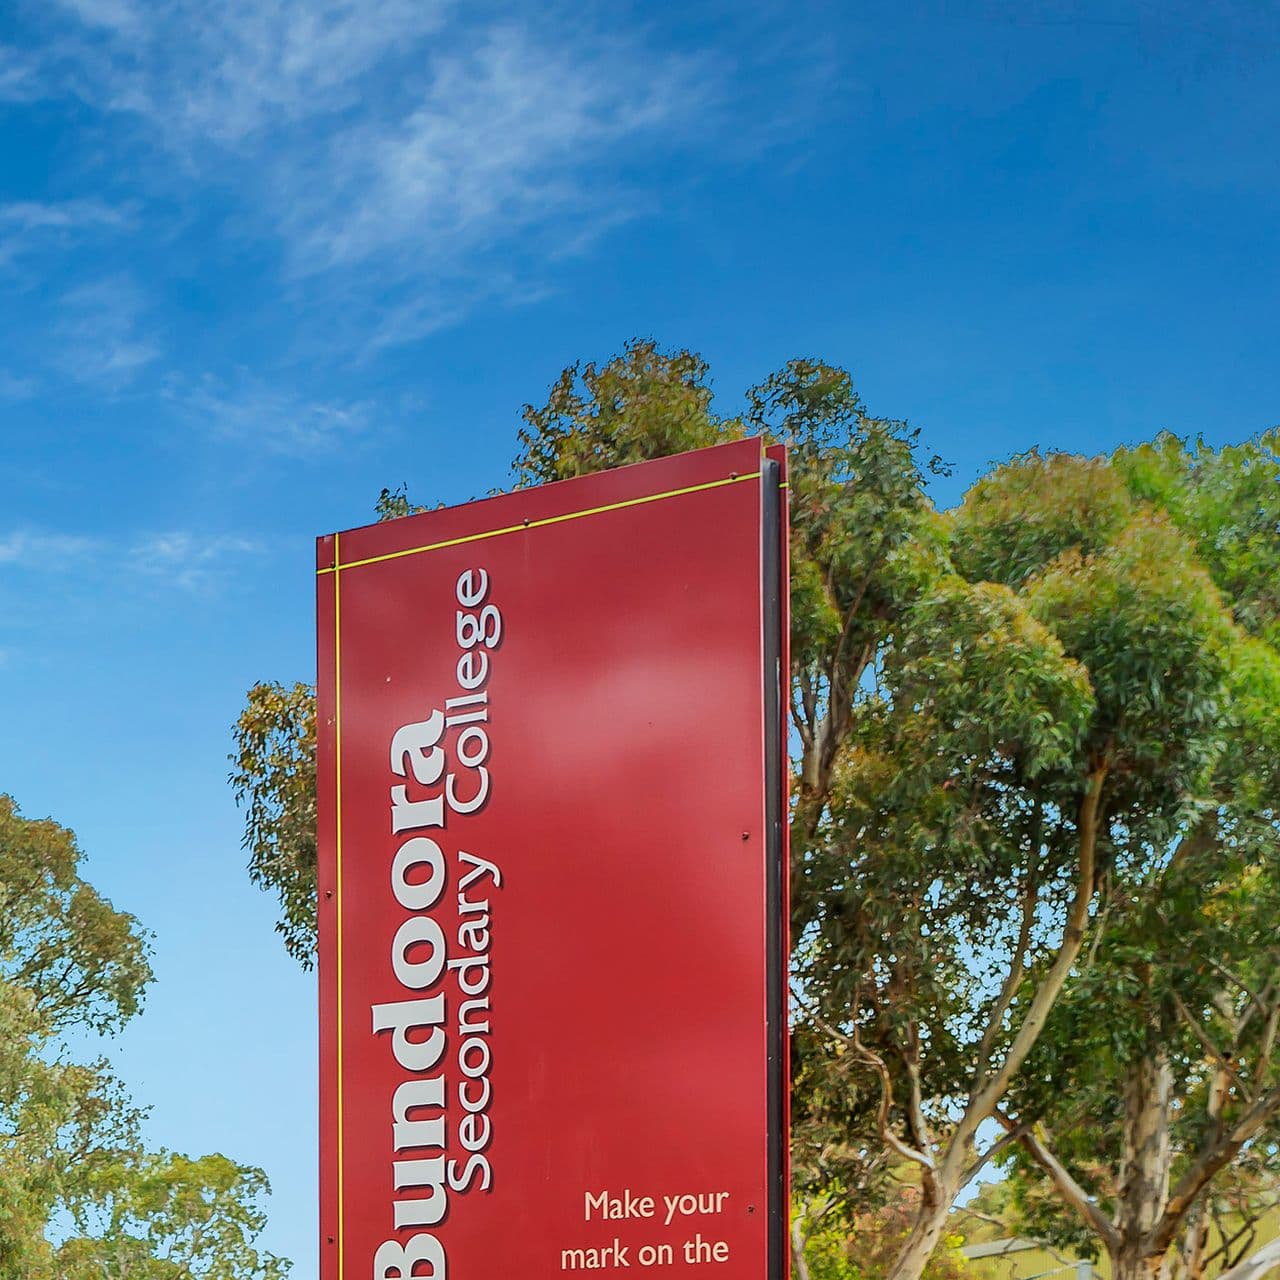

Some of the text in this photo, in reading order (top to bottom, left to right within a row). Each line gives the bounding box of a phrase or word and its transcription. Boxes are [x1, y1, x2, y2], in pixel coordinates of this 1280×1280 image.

[445, 568, 501, 1193] Secondary College
[584, 1189, 730, 1226] Make your
[561, 1234, 729, 1270] mark on the
